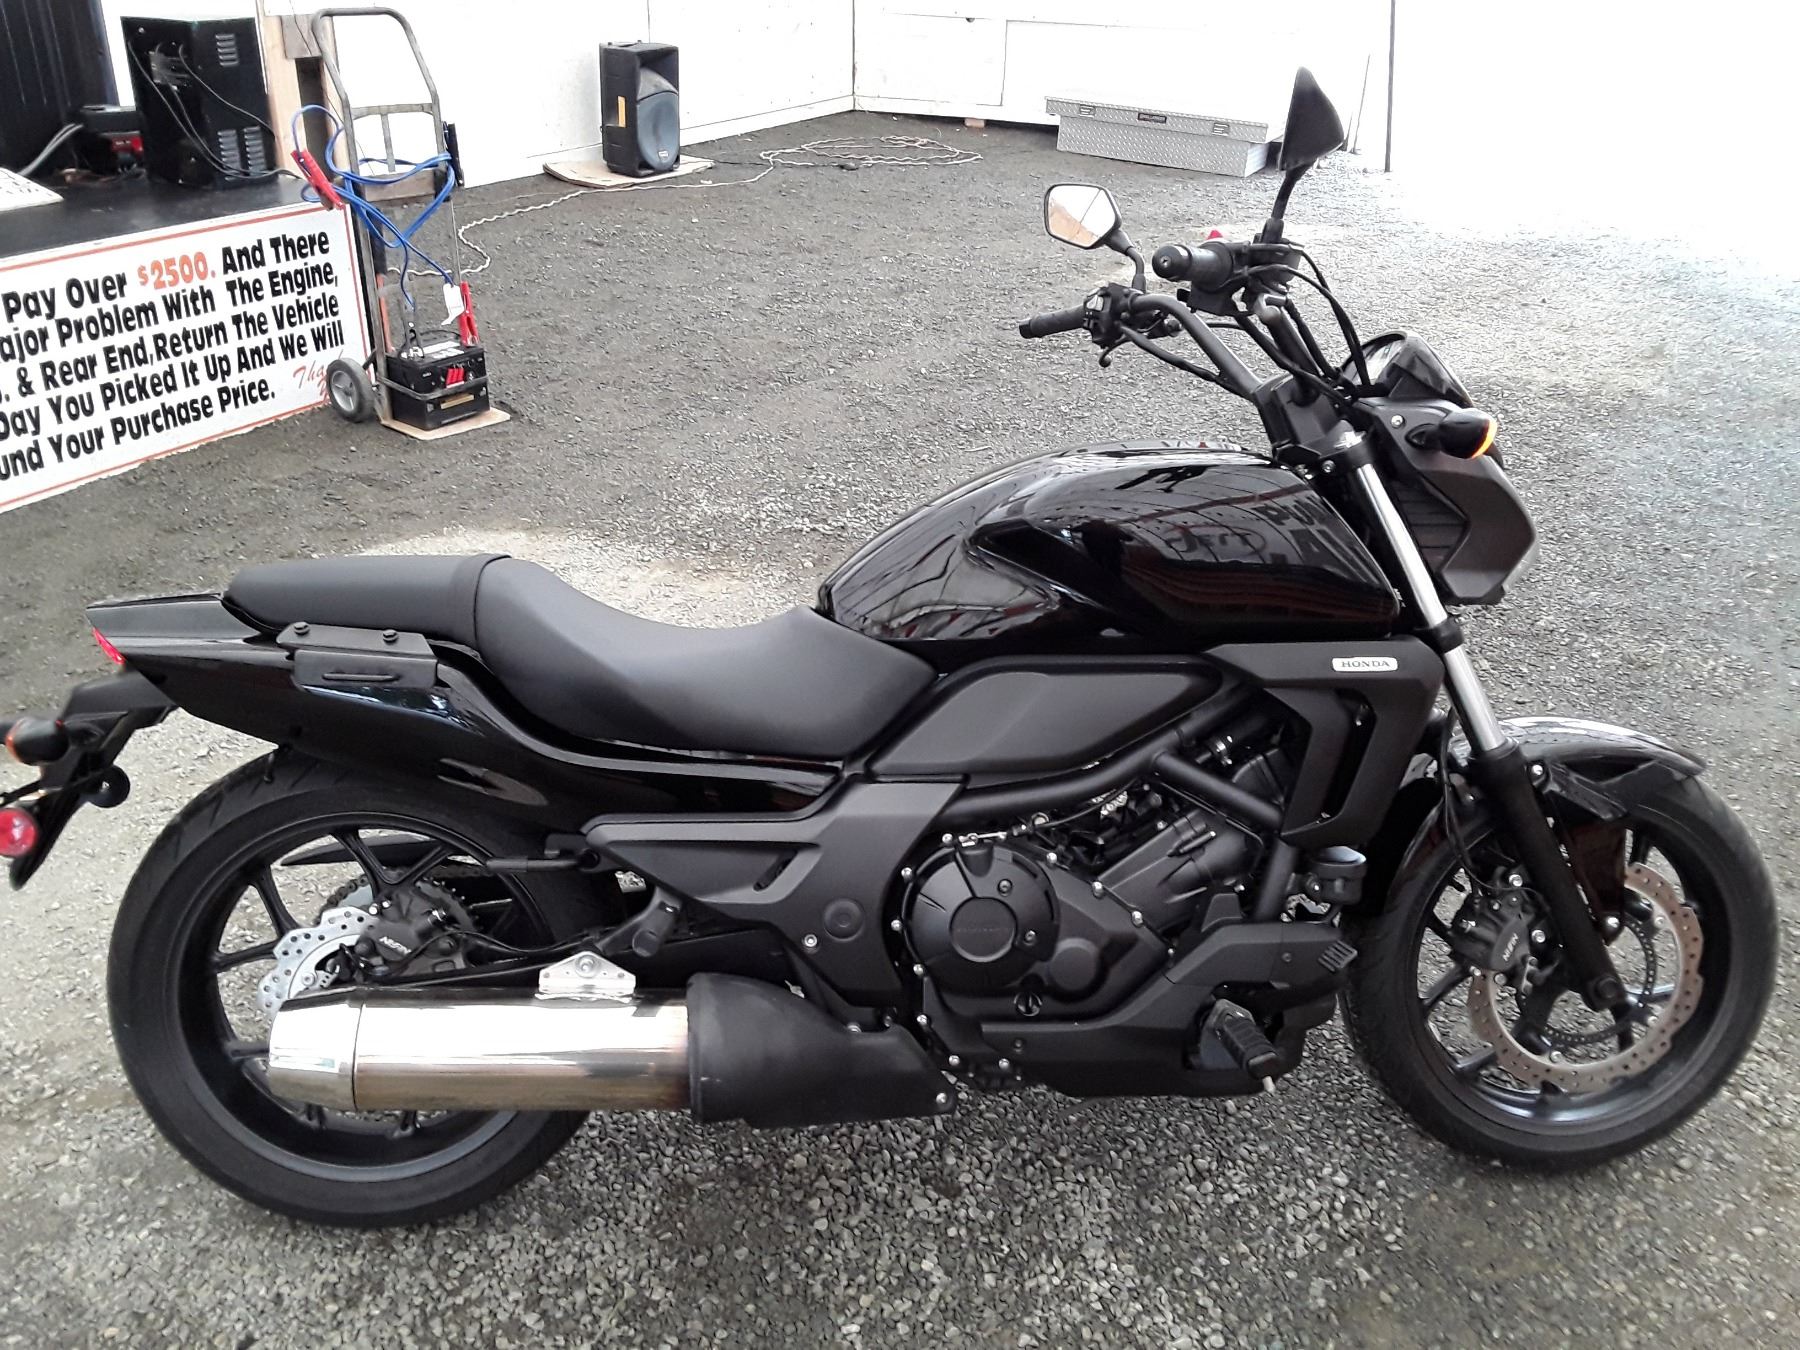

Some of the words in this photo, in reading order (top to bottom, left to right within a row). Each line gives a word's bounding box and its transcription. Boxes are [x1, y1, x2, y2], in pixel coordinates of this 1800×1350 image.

[1, 287, 56, 323] Pay
[66, 272, 127, 309] Over
[137, 251, 216, 289] $2500.
[222, 239, 266, 275] And
[269, 231, 330, 264] There
[55, 301, 159, 348] Problem
[161, 285, 216, 322] With
[225, 277, 265, 307] The
[268, 262, 338, 297] Engine,
[17, 366, 36, 398] &
[39, 354, 98, 391] Rear
[231, 311, 269, 340] The
[271, 292, 340, 331] Vehicle
[47, 392, 95, 425] You
[99, 363, 178, 411] Picked
[181, 359, 200, 388] It
[203, 353, 231, 383] Up
[237, 338, 276, 373] And
[278, 333, 308, 361] We
[310, 319, 344, 352] Will
[47, 426, 105, 463] Your
[110, 395, 214, 445] Purchase
[217, 378, 275, 413] Price.
[1341, 660, 1391, 668] HONDA
